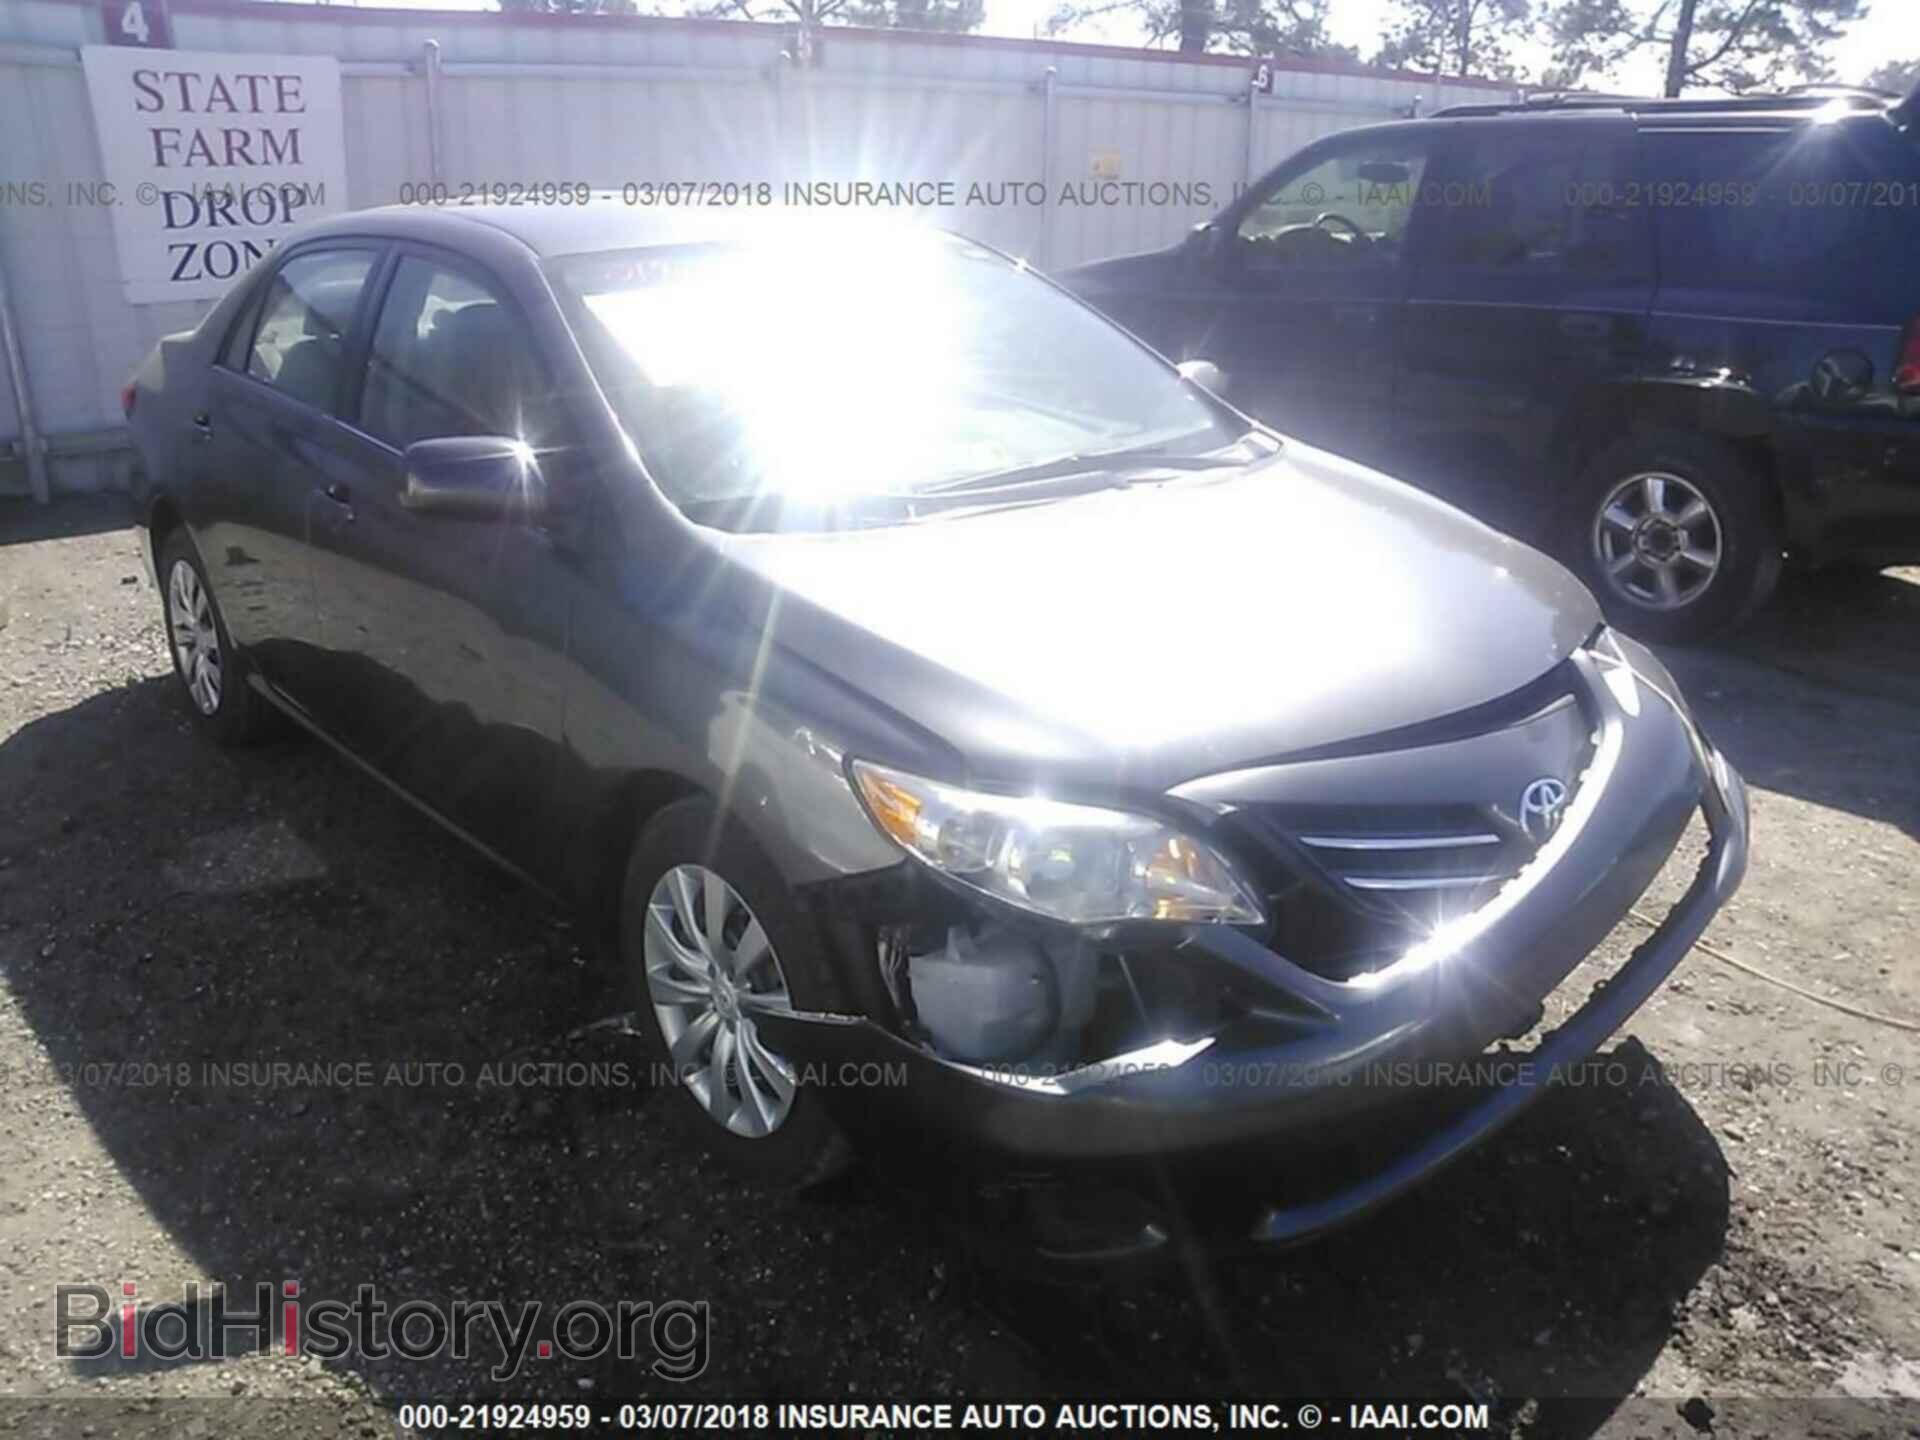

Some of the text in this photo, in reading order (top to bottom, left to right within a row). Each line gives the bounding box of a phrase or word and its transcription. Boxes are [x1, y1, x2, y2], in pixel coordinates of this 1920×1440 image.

[121, 1, 149, 42] 4
[132, 69, 305, 114] STATE
[149, 128, 303, 168] FARM
[160, 187, 306, 230] DROP
[168, 239, 277, 282] ZON
